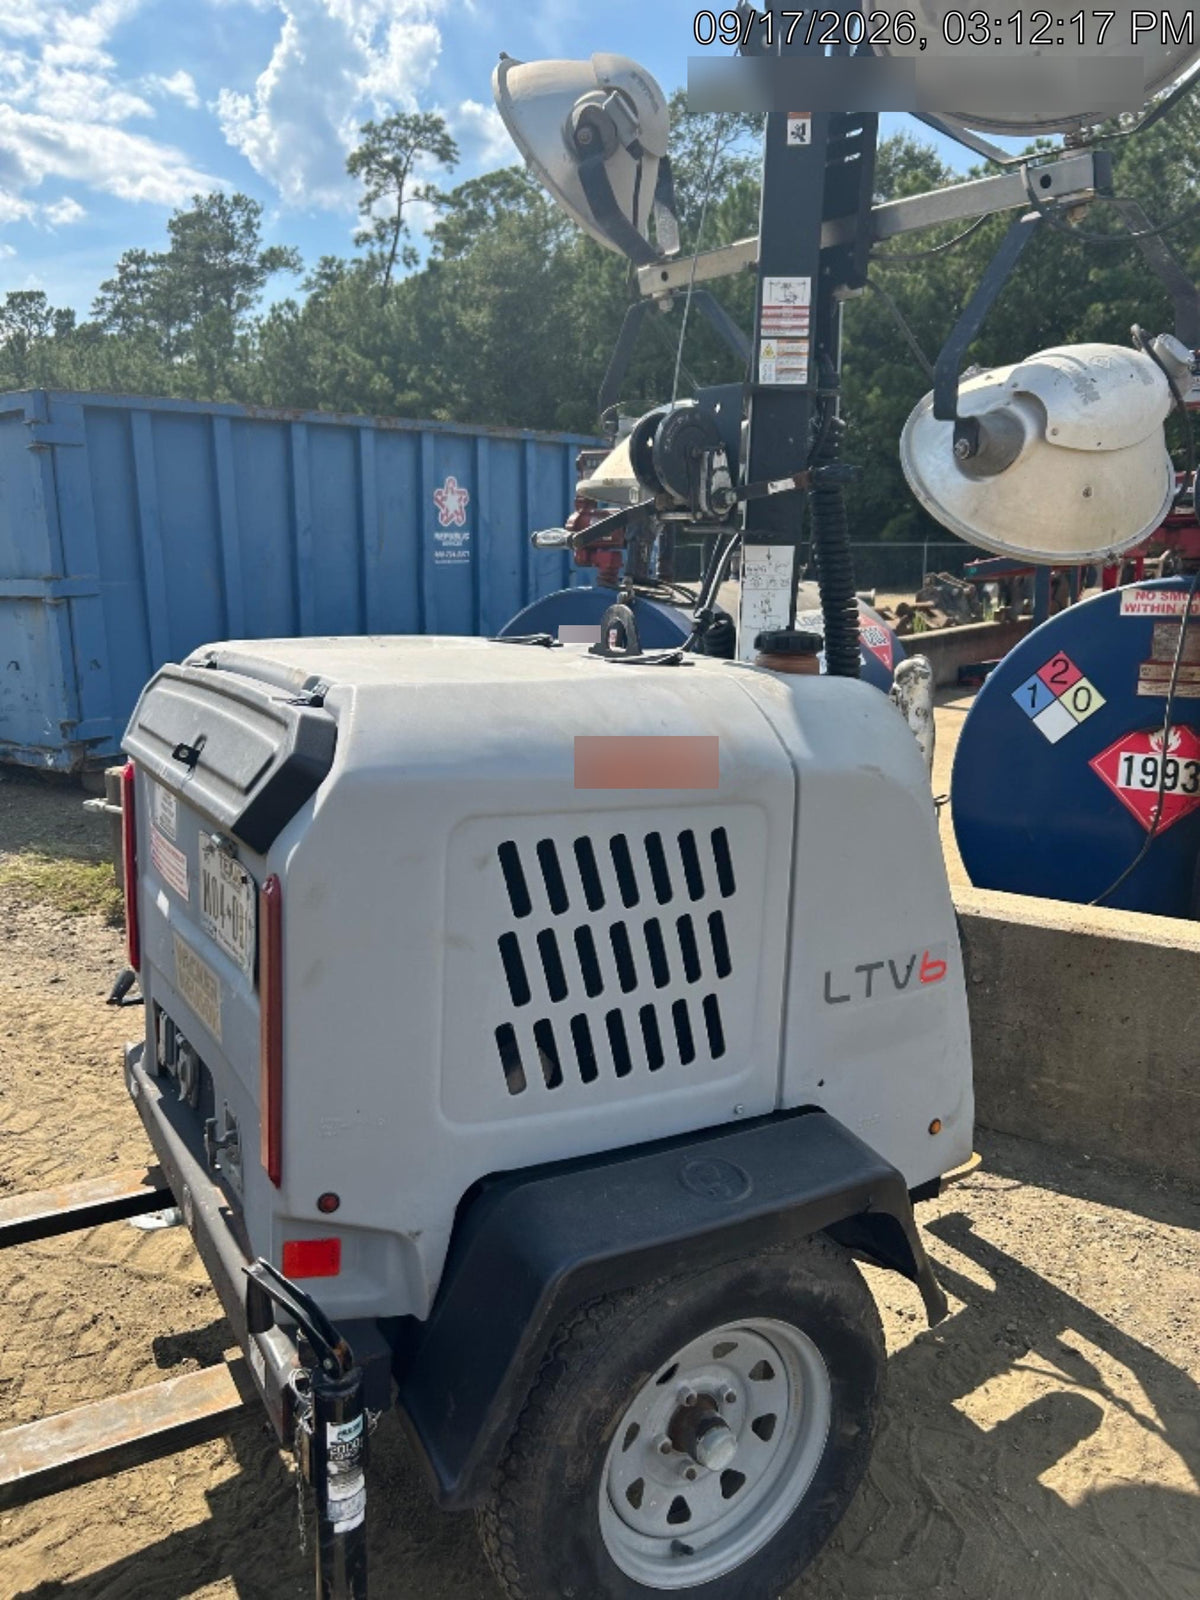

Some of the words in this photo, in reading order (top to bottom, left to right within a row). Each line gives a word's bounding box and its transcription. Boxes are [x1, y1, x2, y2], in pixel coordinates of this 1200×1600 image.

[1123, 602, 1177, 614] WITHIN
[1135, 590, 1156, 601] NO
[1051, 659, 1069, 684] 2
[1027, 685, 1038, 708] 1
[1073, 686, 1091, 712] 0
[1123, 755, 1200, 794] 1993
[823, 949, 948, 1005] LTV6
